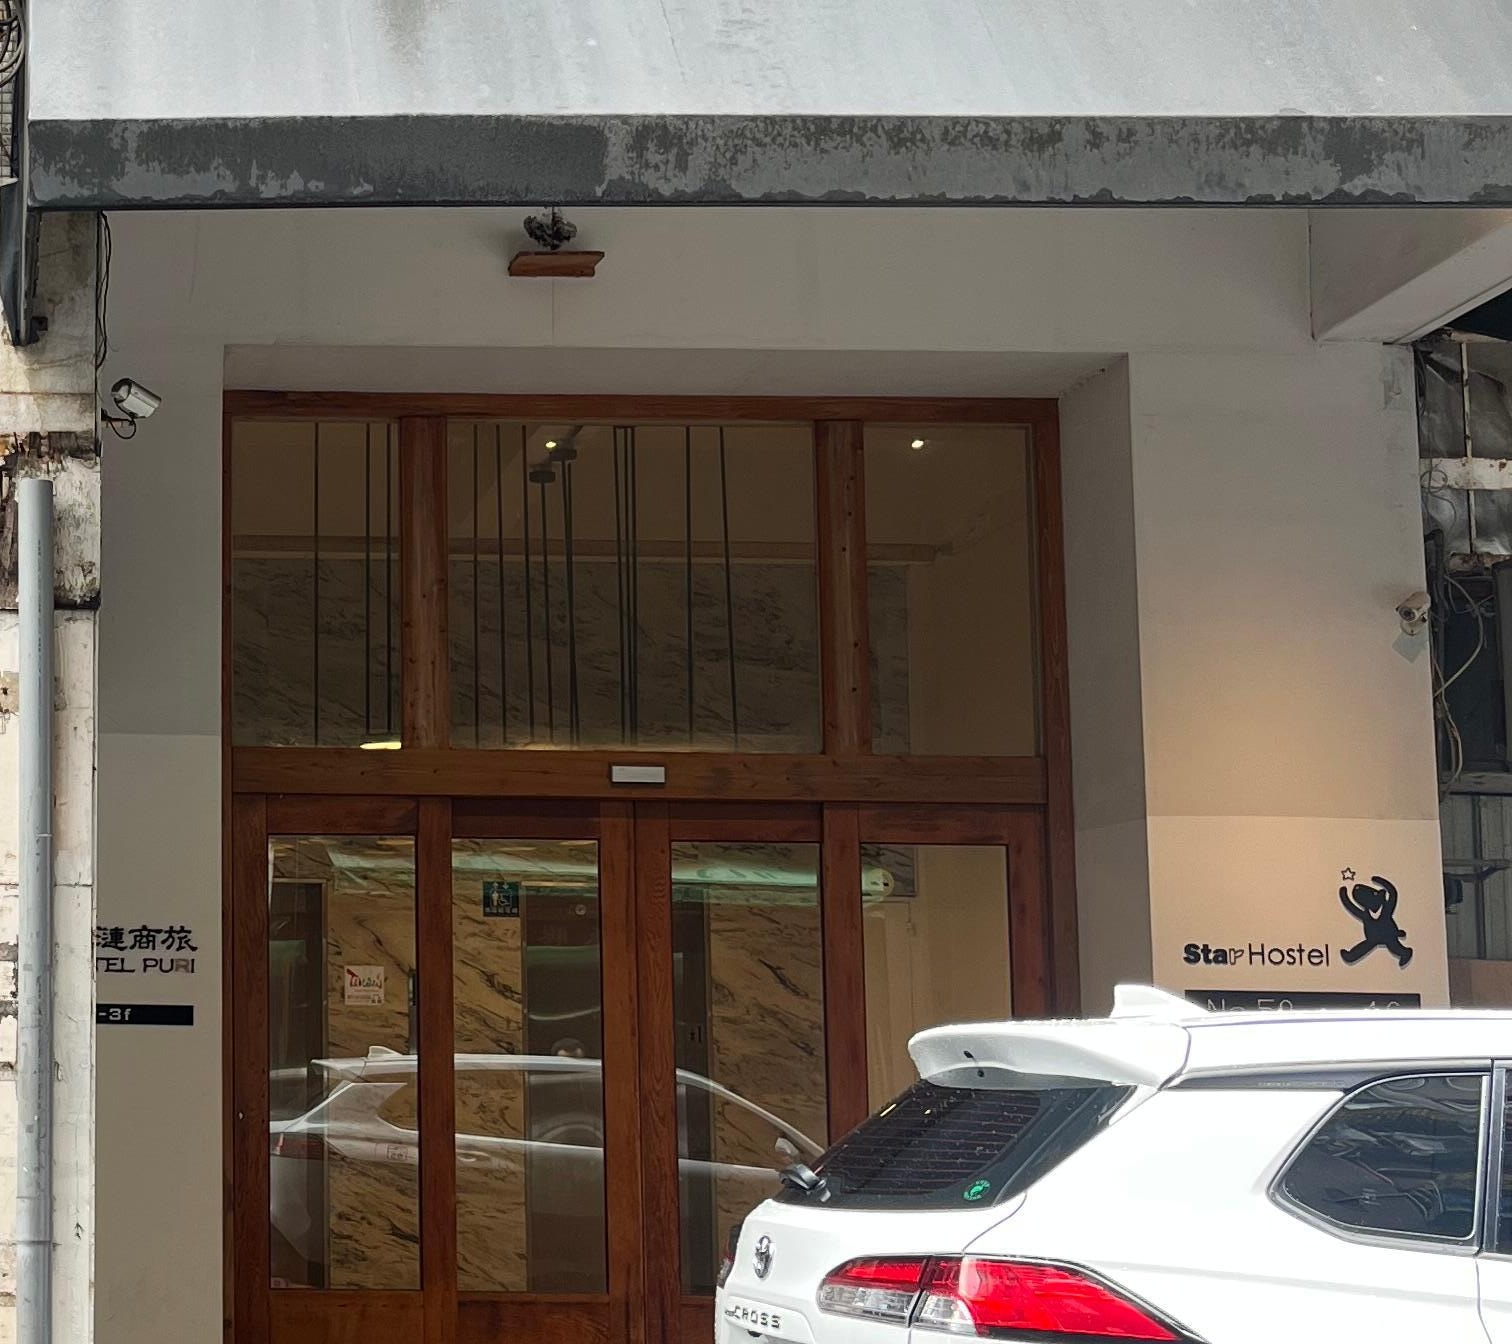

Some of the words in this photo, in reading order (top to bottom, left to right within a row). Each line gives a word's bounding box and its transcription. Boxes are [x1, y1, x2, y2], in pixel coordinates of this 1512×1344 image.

[1183, 943, 1244, 966] Star
[1248, 943, 1329, 967] Hostel
[143, 958, 195, 973] PURI
